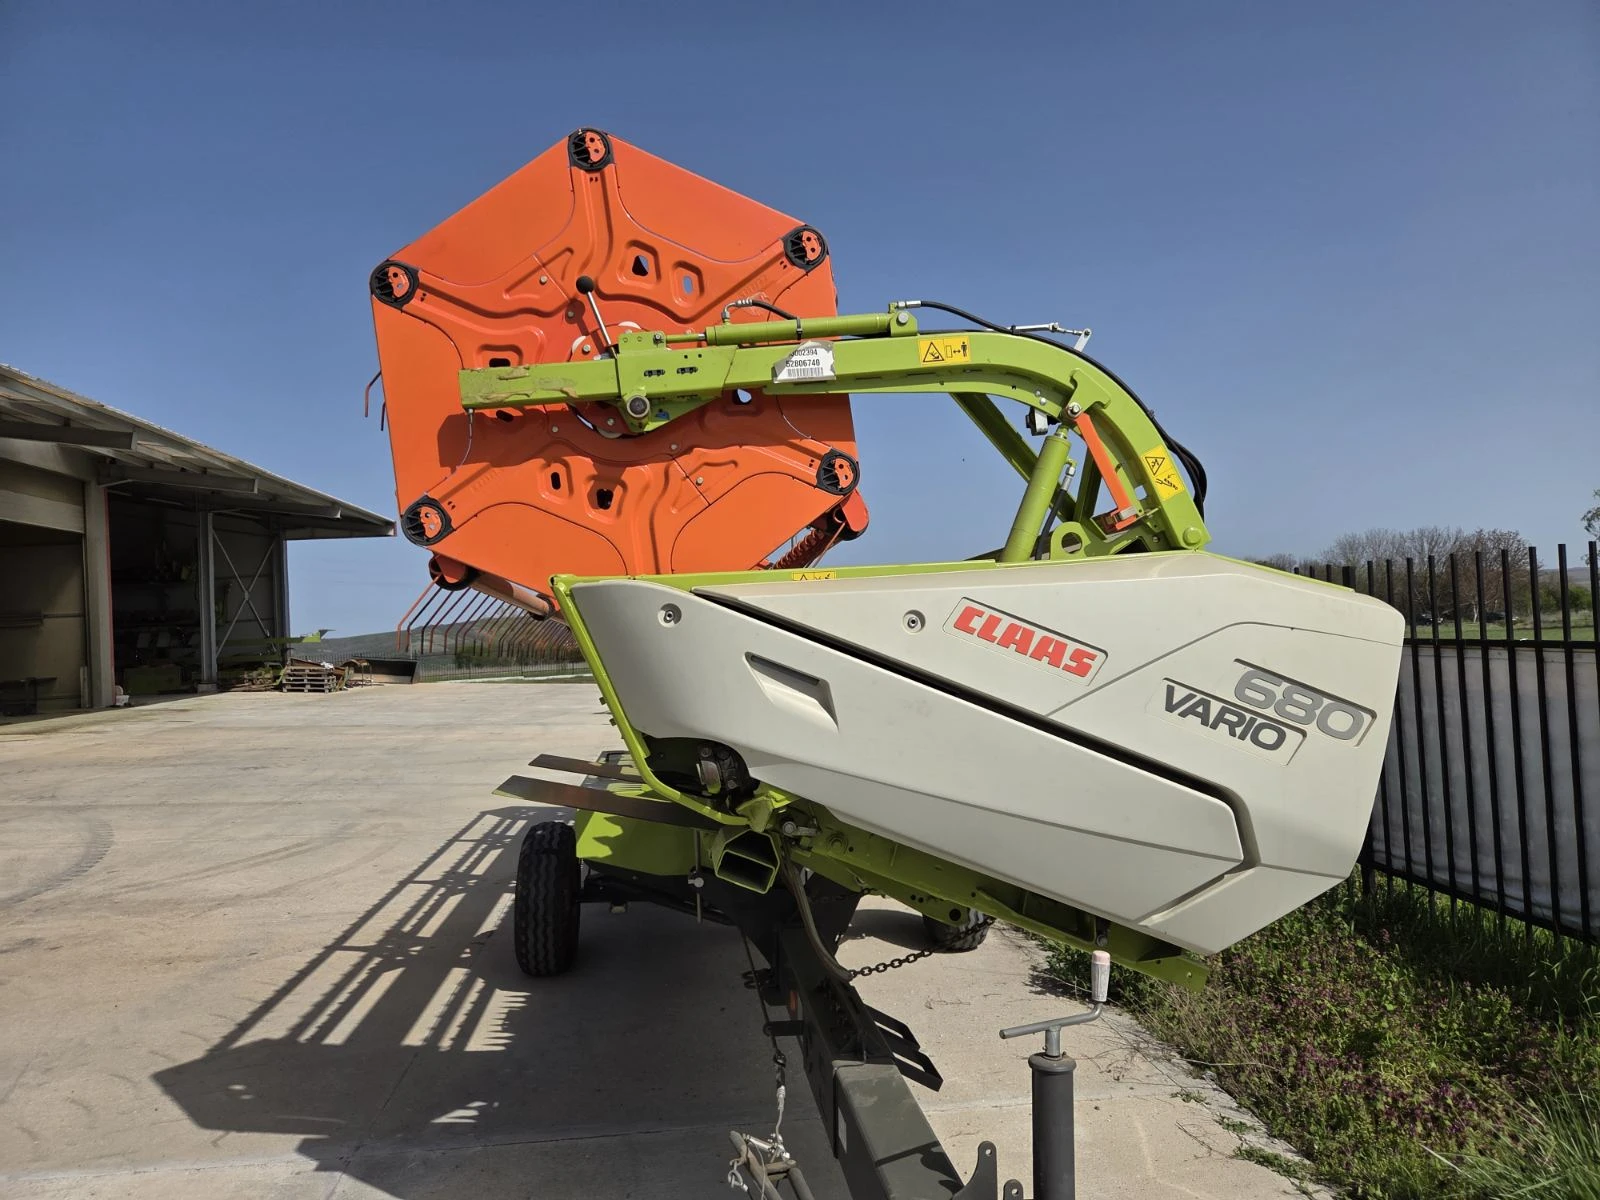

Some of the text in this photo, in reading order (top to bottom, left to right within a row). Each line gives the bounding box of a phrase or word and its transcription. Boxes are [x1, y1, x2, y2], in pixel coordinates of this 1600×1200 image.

[953, 605, 1098, 678] CLAAS
[1163, 684, 1286, 751] VARIO
[1234, 669, 1364, 740] 680
